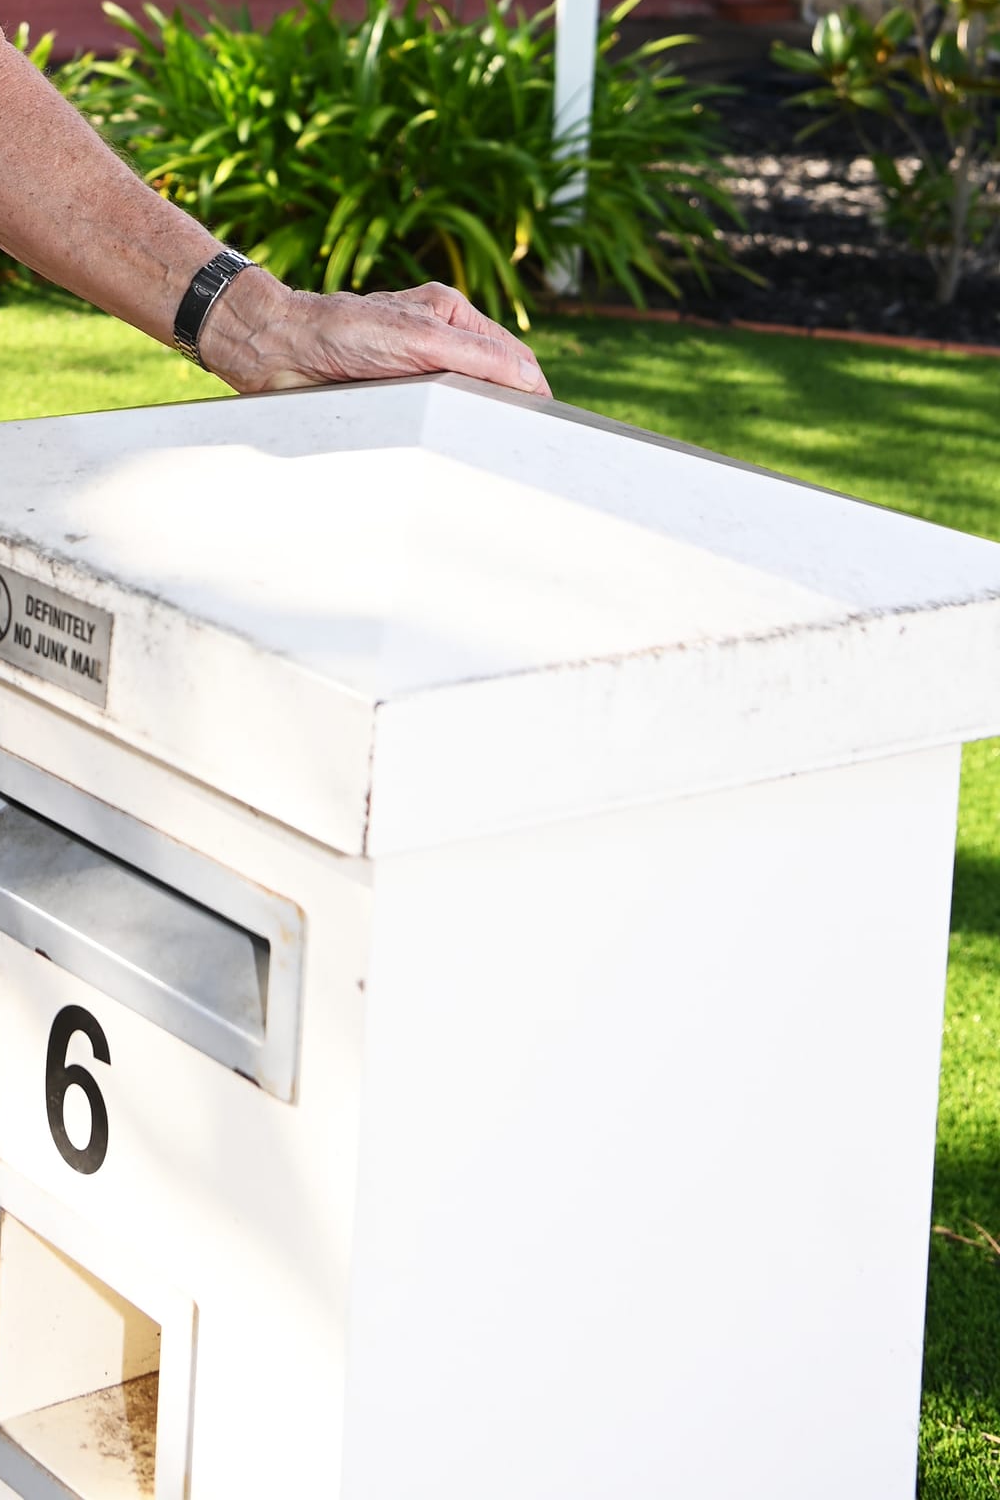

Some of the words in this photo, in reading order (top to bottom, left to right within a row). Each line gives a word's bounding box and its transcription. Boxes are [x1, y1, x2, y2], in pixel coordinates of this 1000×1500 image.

[25, 594, 96, 645] DEFINITELY
[14, 622, 32, 650] NO
[34, 633, 68, 668] JUNK
[71, 649, 102, 684] MAIL
[46, 1004, 111, 1175] 6
